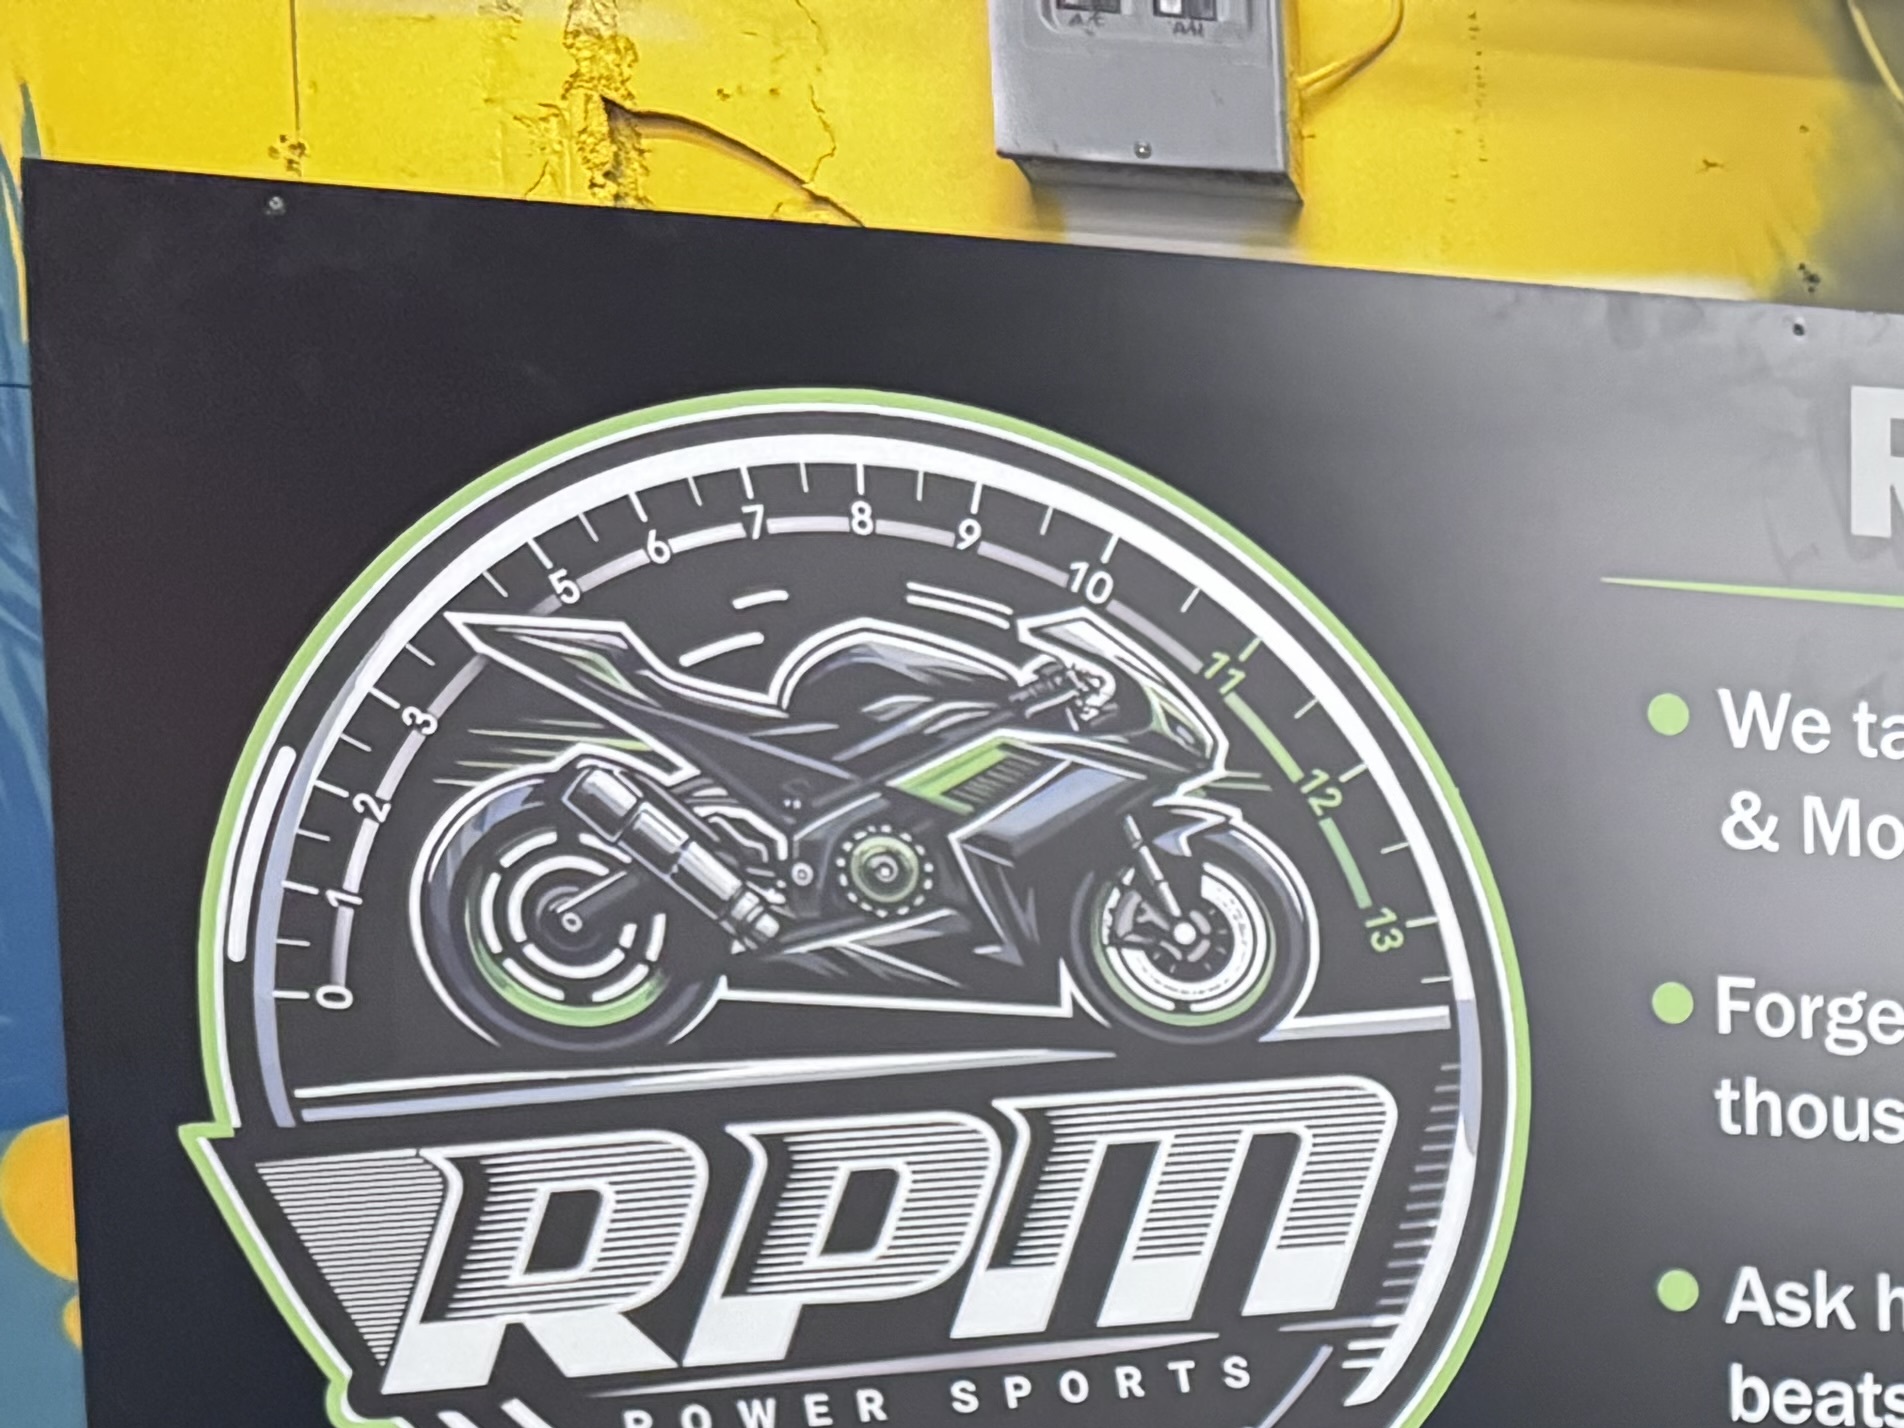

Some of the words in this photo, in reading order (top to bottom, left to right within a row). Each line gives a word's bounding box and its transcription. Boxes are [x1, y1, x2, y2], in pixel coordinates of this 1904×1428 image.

[325, 888, 363, 906] 1
[352, 793, 391, 823] 2
[401, 705, 438, 735] 3
[547, 570, 580, 603] 5
[645, 530, 671, 563] 6
[743, 504, 769, 539] 7
[850, 501, 874, 535] 8
[957, 519, 982, 549] 9
[1069, 561, 1114, 603] 10
[1203, 651, 1247, 694] 11
[1302, 769, 1342, 815] 12
[1366, 906, 1404, 952] 13
[1717, 688, 1832, 755] We
[1721, 790, 1782, 856] &
[380, 1075, 1400, 1396] RPM
[1723, 1265, 1857, 1331] Ask
[950, 1353, 1254, 1416] SPORTS
